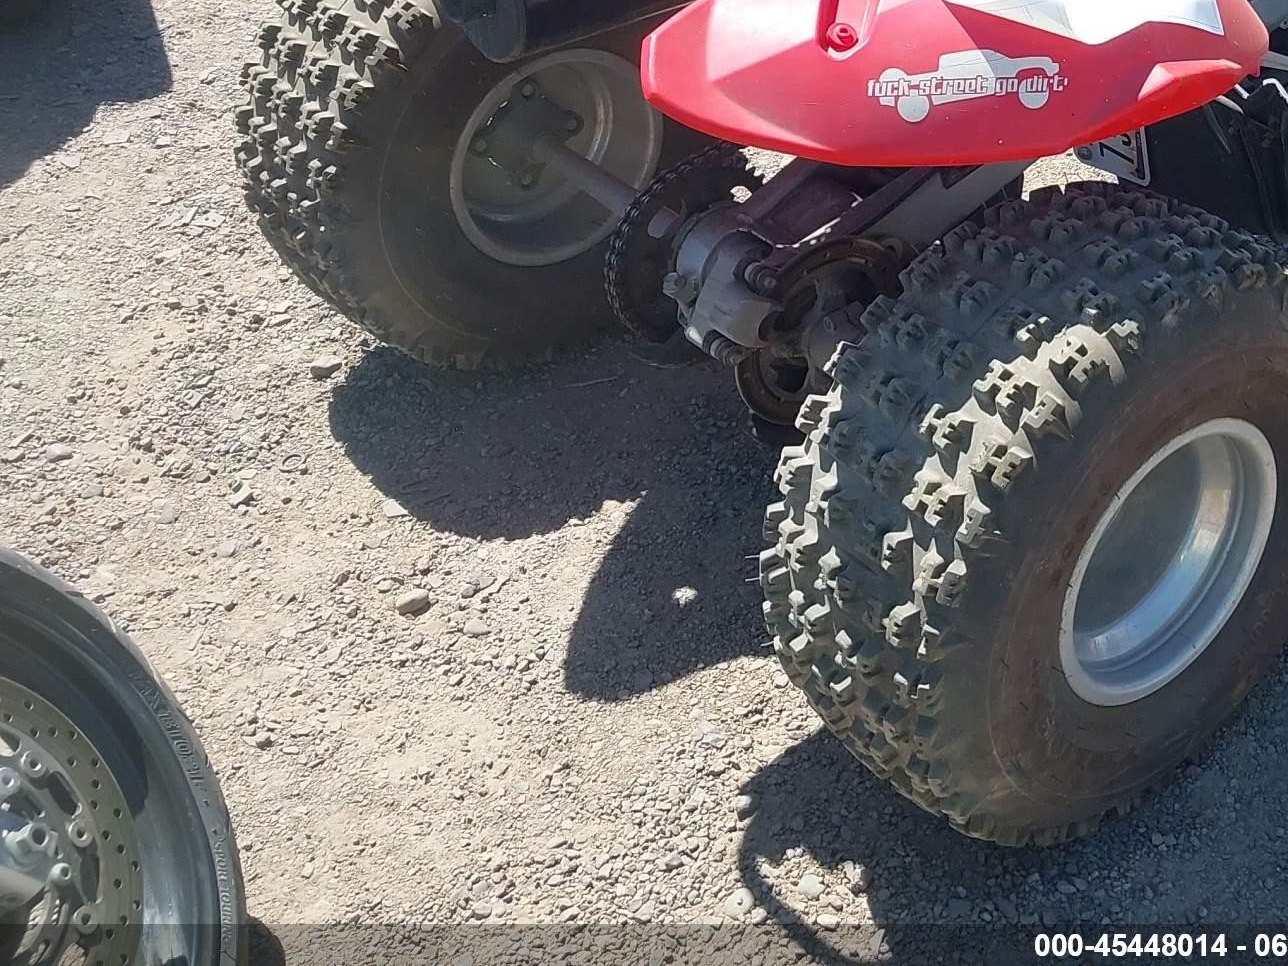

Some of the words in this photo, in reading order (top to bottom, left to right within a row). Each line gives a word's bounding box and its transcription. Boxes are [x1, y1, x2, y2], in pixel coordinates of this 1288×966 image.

[867, 78, 911, 97] fuck
[918, 75, 988, 96] street
[995, 77, 1018, 96] go
